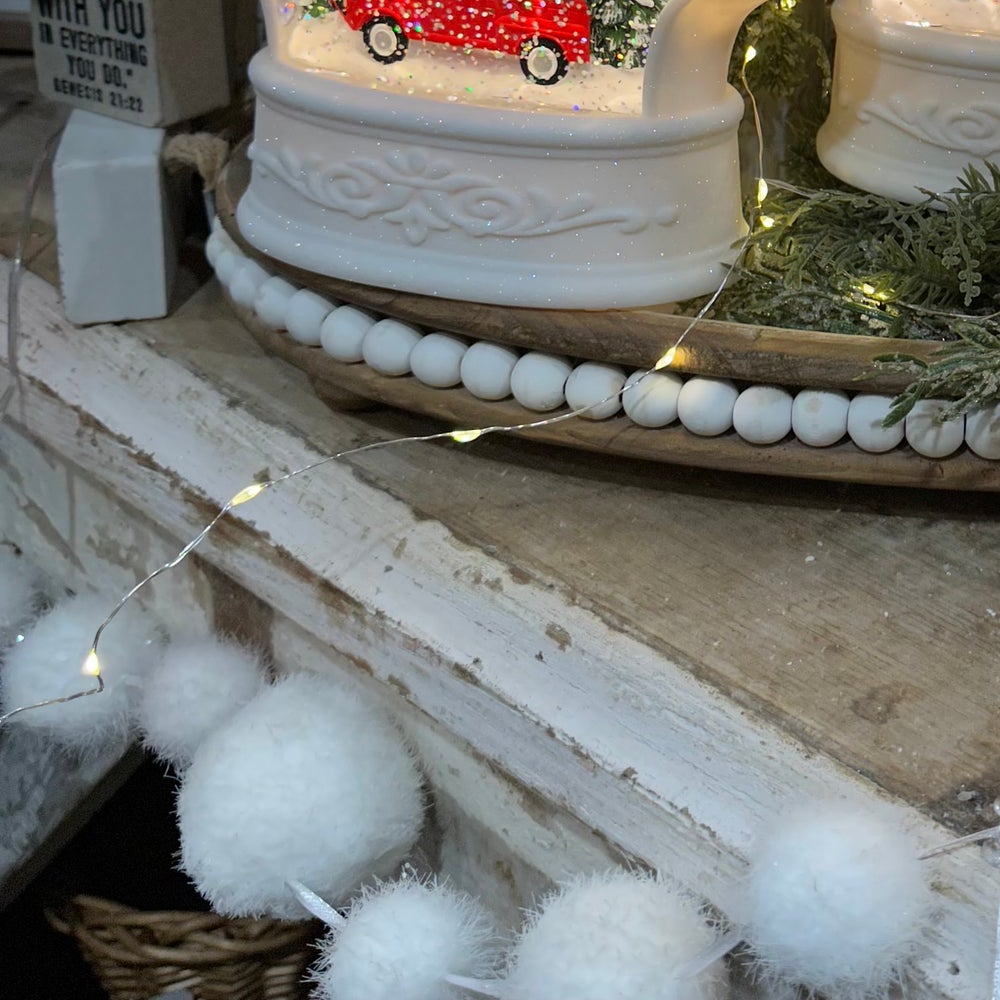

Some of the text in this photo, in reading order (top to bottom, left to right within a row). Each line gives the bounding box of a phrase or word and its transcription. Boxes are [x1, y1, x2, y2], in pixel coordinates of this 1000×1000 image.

[39, 21, 148, 67] IN EVERYTHING
[66, 54, 96, 81] YOU
[53, 77, 104, 103] GENESIS
